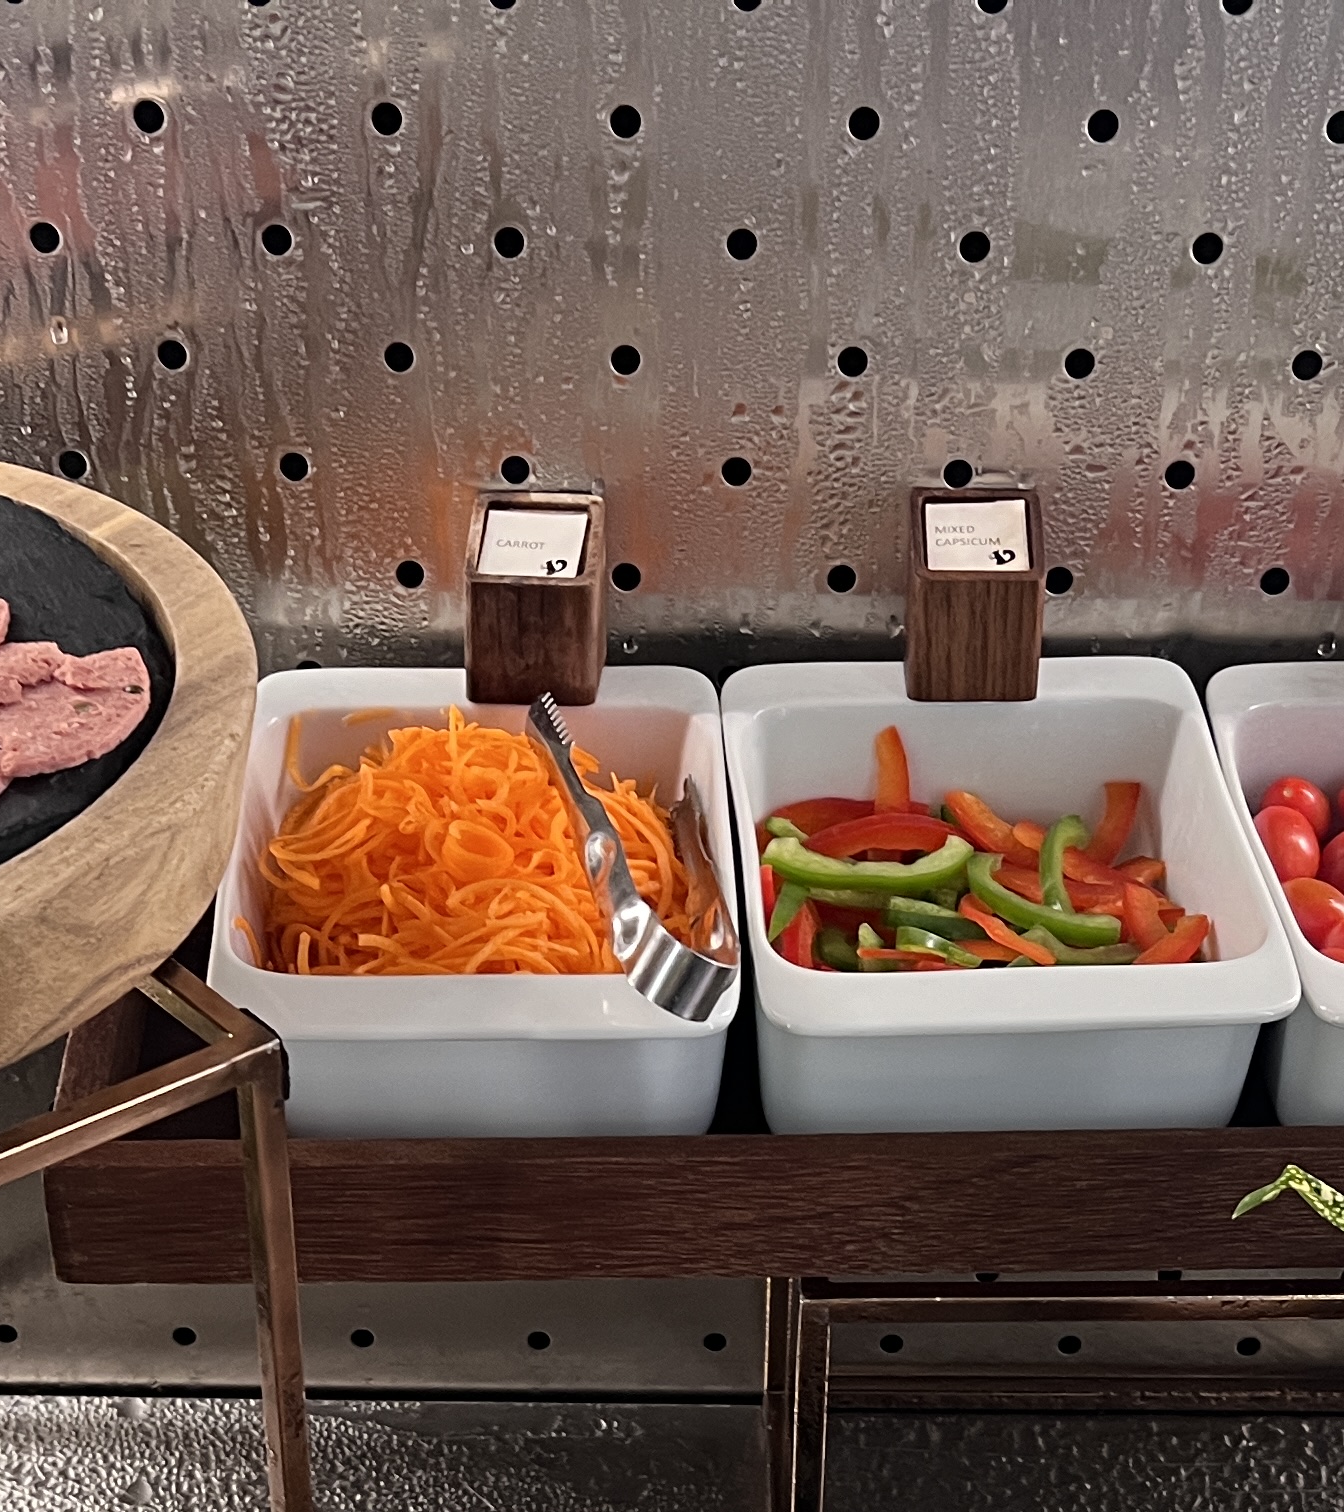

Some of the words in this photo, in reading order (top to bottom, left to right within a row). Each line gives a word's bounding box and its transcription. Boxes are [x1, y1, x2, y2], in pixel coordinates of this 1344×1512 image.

[934, 525, 975, 534] MIXED
[496, 539, 545, 550] CARROT
[935, 537, 1002, 547] CAPSICUM
